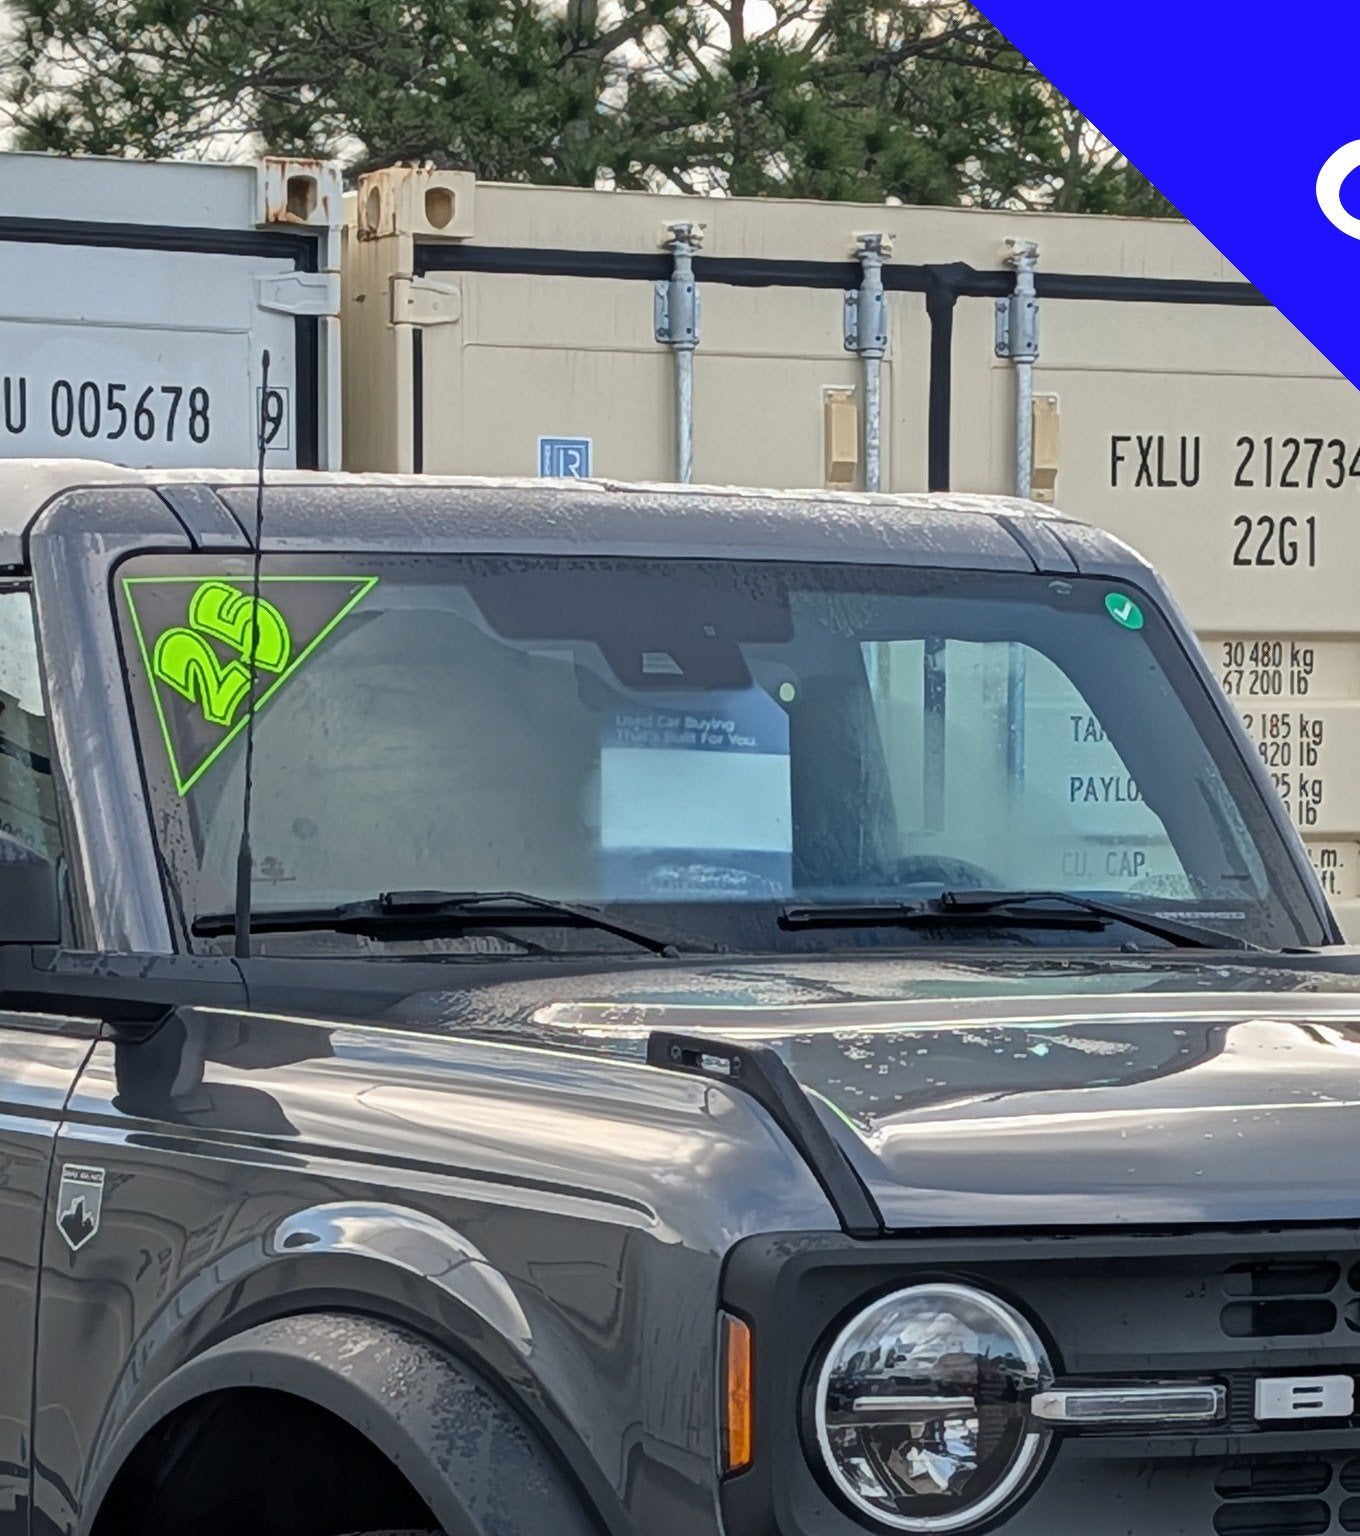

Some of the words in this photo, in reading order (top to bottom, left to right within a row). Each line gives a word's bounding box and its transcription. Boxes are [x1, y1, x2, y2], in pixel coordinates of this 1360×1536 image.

[51, 380, 210, 443] 005678
[1111, 435, 1200, 487] FXLU
[1233, 515, 1316, 567] 22G1
[153, 580, 291, 727] 25
[1249, 641, 1283, 668] 480
[1290, 642, 1315, 675] kg
[1249, 670, 1283, 695] 200
[1290, 670, 1309, 695] lb
[1261, 714, 1291, 739] 185
[1299, 713, 1323, 746] kg
[1299, 741, 1318, 767] lb
[1070, 777, 1142, 802] PAYLO
[1299, 772, 1323, 805] kg
[1299, 800, 1318, 825] lb
